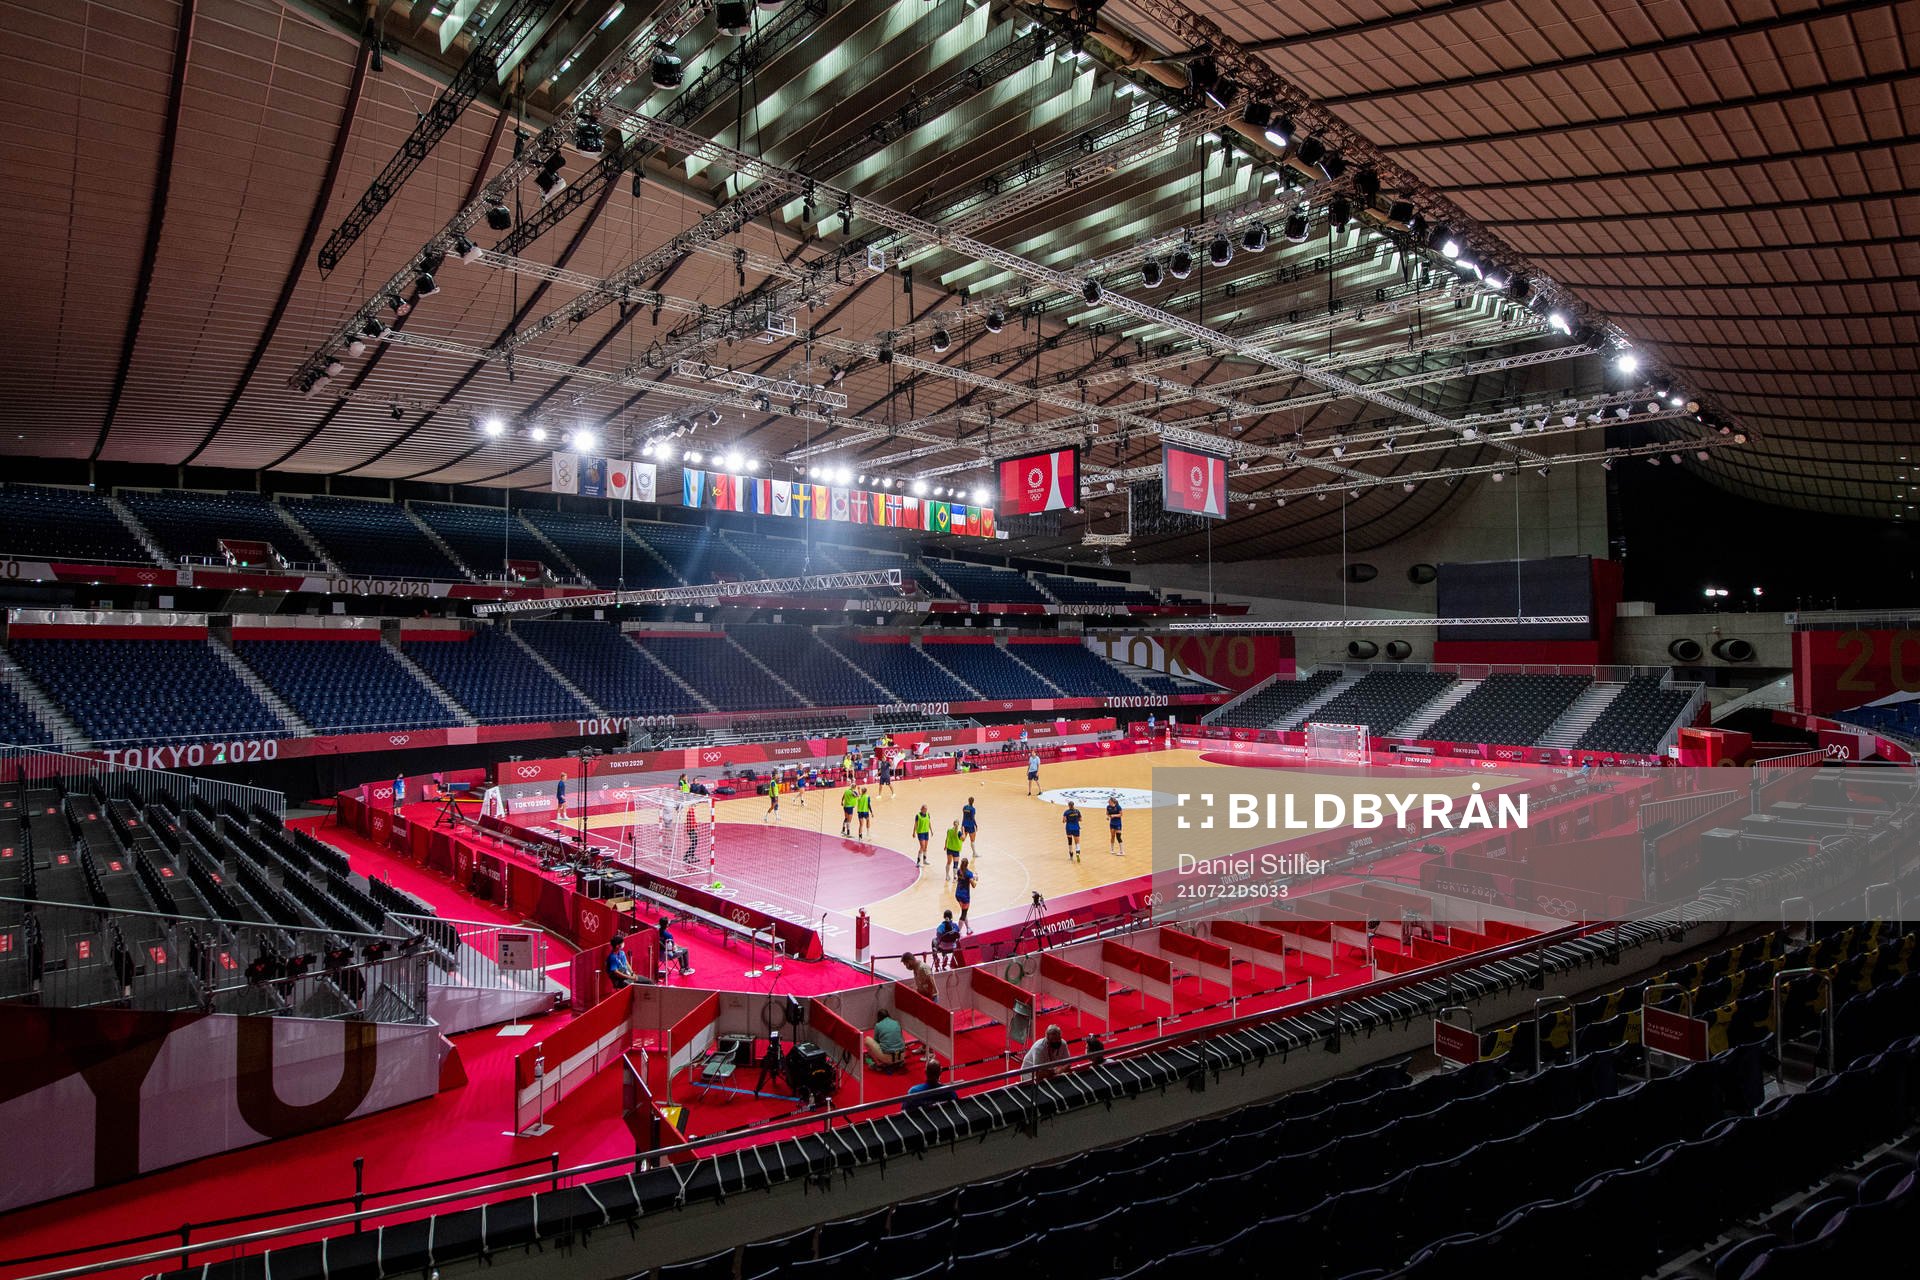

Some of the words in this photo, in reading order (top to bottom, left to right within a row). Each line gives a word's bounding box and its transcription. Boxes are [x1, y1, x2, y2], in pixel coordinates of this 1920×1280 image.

[326, 579, 385, 596] TOKYO
[389, 582, 430, 597] 2020
[858, 600, 892, 611] TOKYO
[894, 600, 919, 612] 2020
[1057, 605, 1089, 615] TOKYO
[1096, 633, 1256, 677] TOKYO
[1107, 696, 1143, 708] TOKYO
[1143, 695, 1169, 707] 2020
[921, 702, 949, 716] 2020
[103, 744, 205, 773] TOKYO
[212, 739, 278, 765] 2020
[536, 799, 551, 807] 2020
[1056, 918, 1076, 932] 2020
